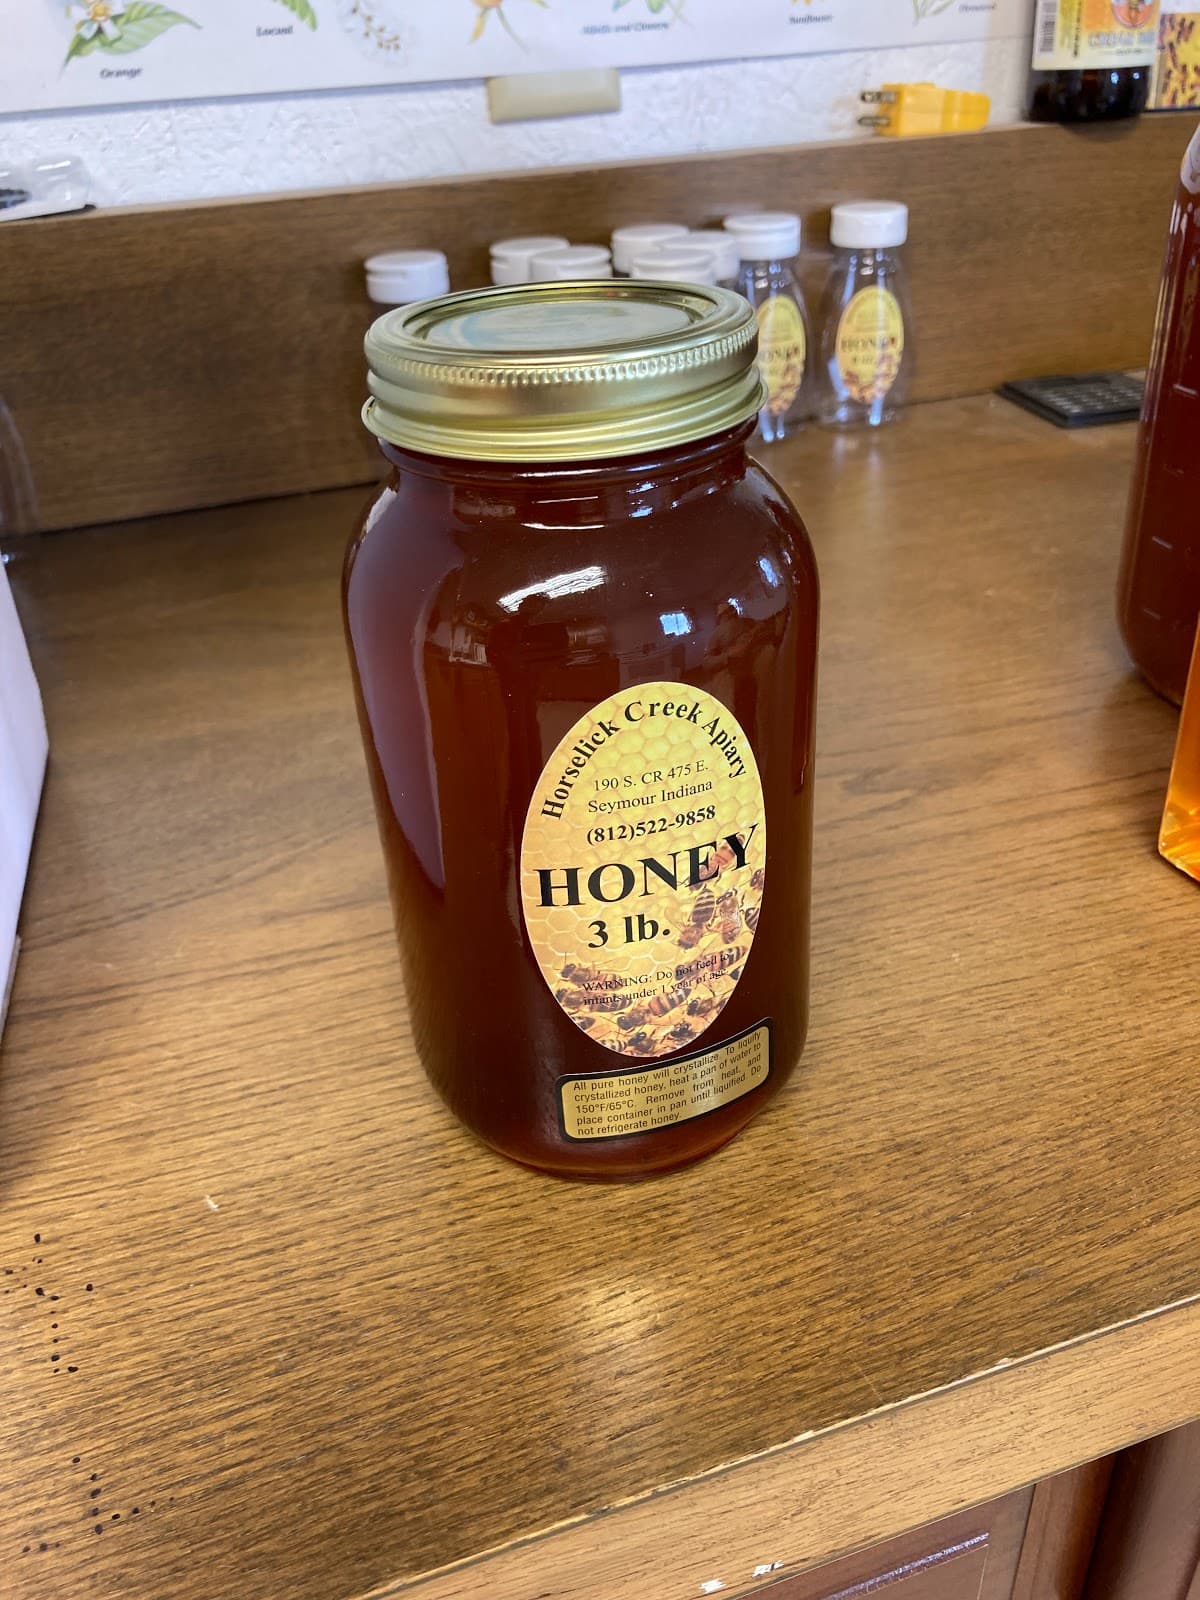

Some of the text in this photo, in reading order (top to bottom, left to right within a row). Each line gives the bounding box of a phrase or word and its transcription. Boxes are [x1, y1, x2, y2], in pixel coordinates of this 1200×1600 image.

[541, 700, 746, 820] Horselick Creek Apiary
[594, 760, 708, 792] 190 S. CR 475 E.
[588, 780, 712, 814] Seymour Indiana
[586, 805, 716, 847] (812)522-9858
[534, 823, 758, 908] HONEY
[588, 914, 671, 949] 3 lb.
[582, 952, 730, 992] WARNING: Do not feed to
[584, 993, 622, 1006] infants
[624, 988, 658, 1000] under
[671, 979, 693, 994] year
[696, 972, 708, 985] of
[573, 1081, 587, 1091] All
[591, 1080, 614, 1091] pure
[618, 1075, 649, 1086] honey
[653, 1068, 670, 1079] will
[725, 1046, 735, 1055] To
[738, 1031, 761, 1050] liquify
[574, 1088, 631, 1102] crystallized
[669, 1075, 689, 1088] heat
[700, 1066, 717, 1079] pan
[719, 1059, 728, 1070] of
[730, 1047, 751, 1064] water
[753, 1042, 761, 1052] to
[646, 1088, 685, 1105] Remove
[693, 1078, 714, 1092] from
[747, 1053, 761, 1067] and
[577, 1115, 603, 1126] place
[607, 1108, 653, 1123] container
[657, 1104, 666, 1113] in
[670, 1099, 687, 1112] pan
[690, 1090, 710, 1104] until
[750, 1065, 761, 1076] Do
[578, 1127, 594, 1136] not
[597, 1119, 648, 1135] refrigerate
